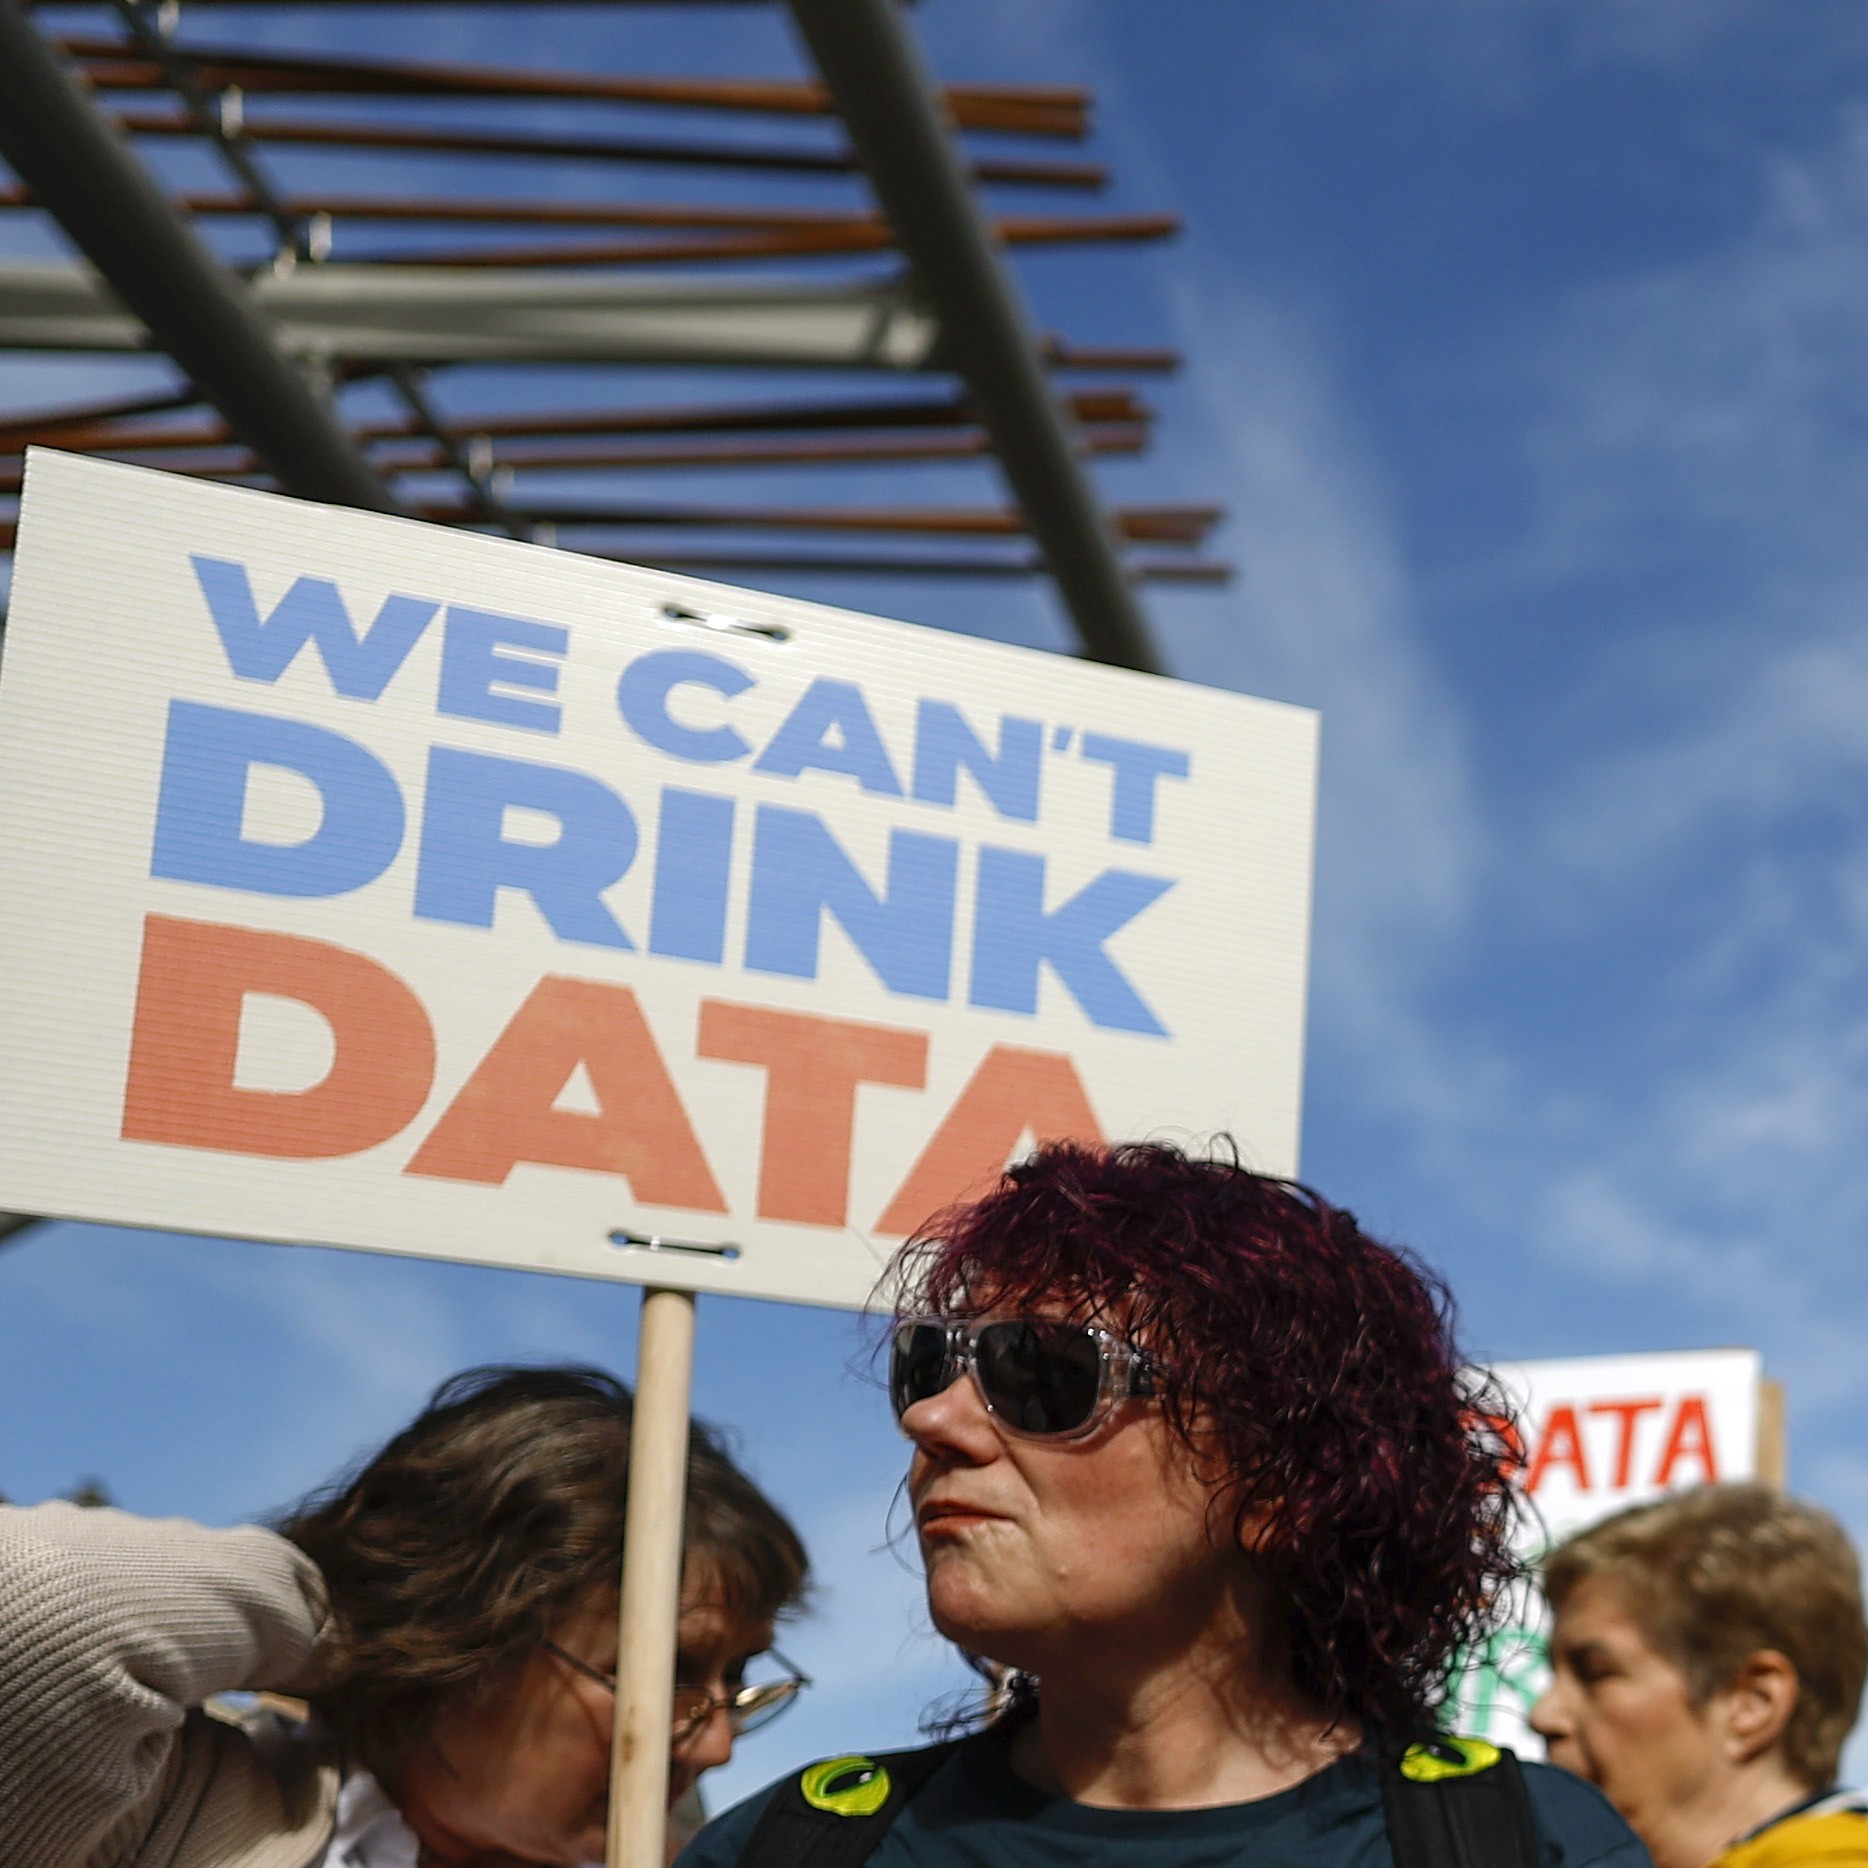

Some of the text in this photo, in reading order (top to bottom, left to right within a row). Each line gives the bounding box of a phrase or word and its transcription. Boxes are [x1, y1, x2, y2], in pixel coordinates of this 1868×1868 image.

[188, 553, 1190, 847] WE CAN'T
[149, 697, 1178, 1040] DRINK
[119, 911, 1112, 1237] DATA
